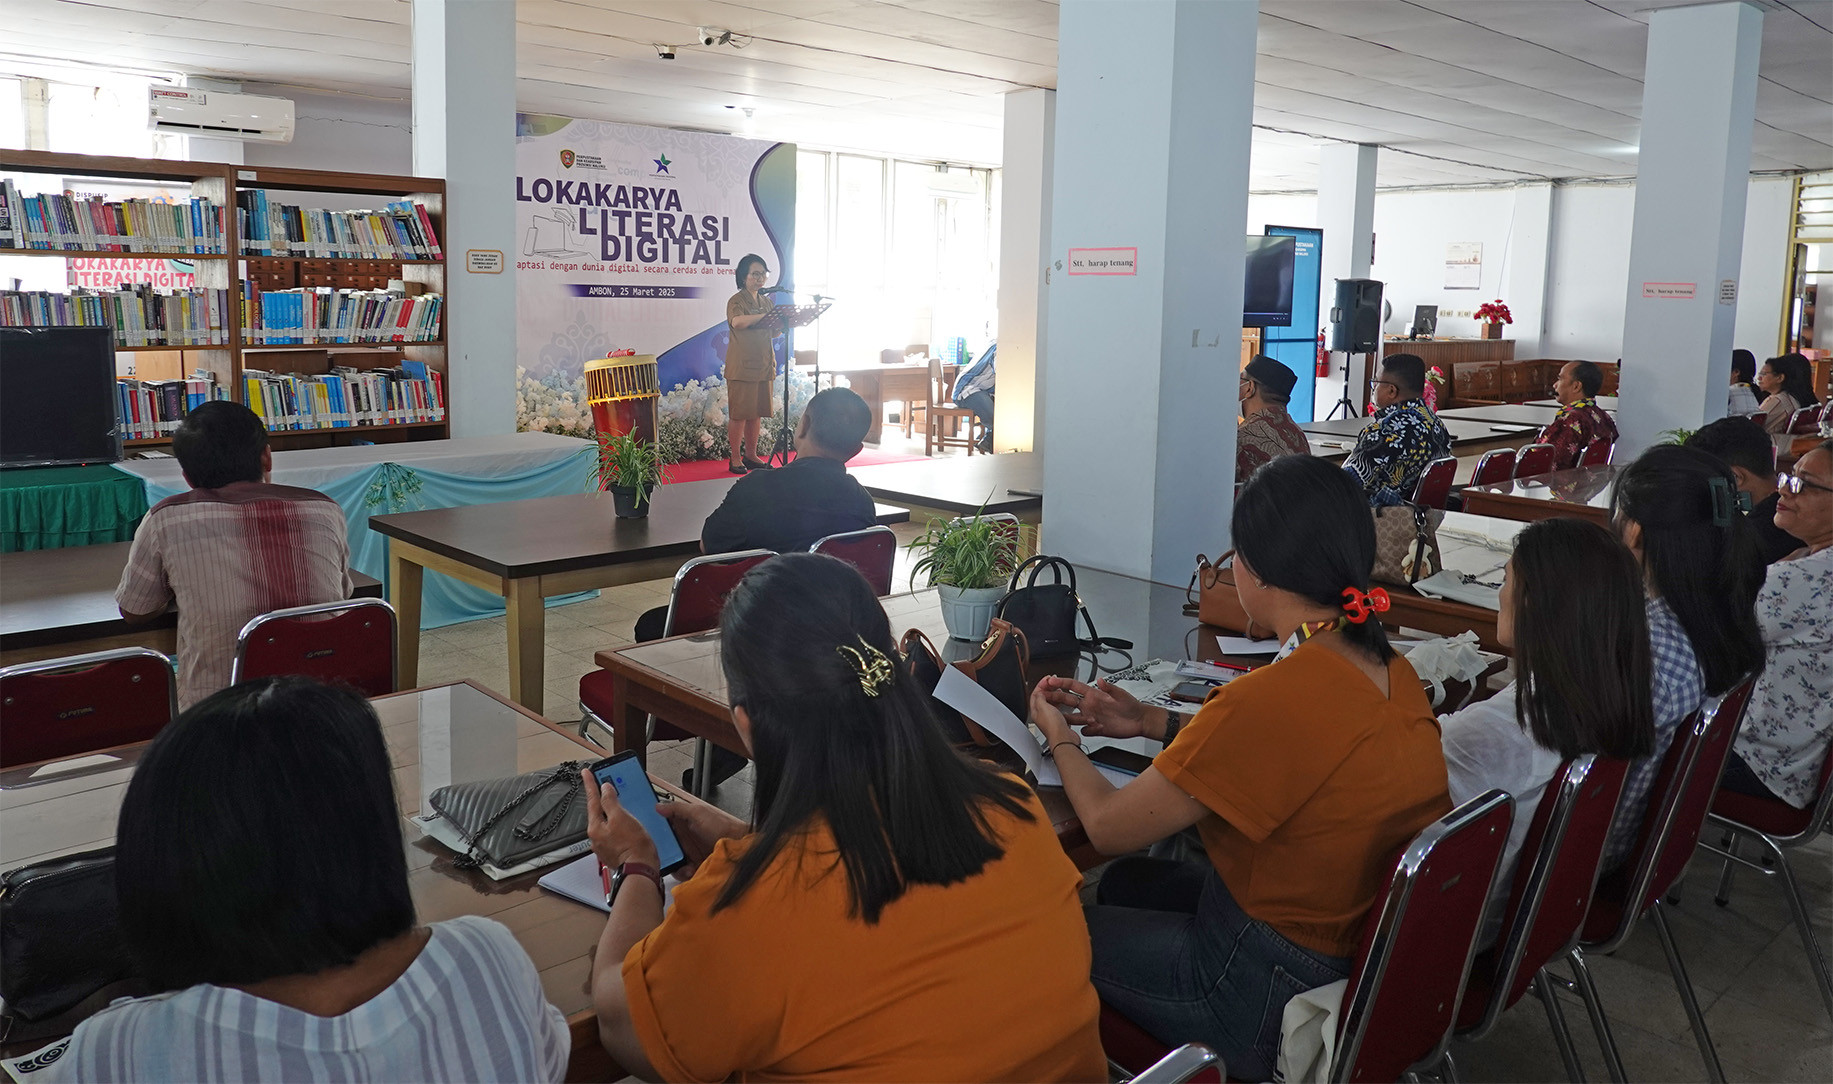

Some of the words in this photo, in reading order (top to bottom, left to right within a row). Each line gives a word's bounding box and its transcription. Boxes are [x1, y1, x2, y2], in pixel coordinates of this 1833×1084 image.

[516, 176, 683, 212] LOKAKARYA
[579, 207, 730, 242] LITERASI
[600, 234, 731, 266] DIGITAL
[516, 260, 546, 271] aptasi
[549, 261, 578, 273] dengan
[581, 262, 605, 272] dunia
[608, 263, 640, 274] digital
[643, 264, 669, 274] secara
[672, 265, 698, 275] cerdas
[700, 266, 714, 275] dan
[1088, 259, 1108, 268] harap
[1110, 260, 1134, 268] tenang
[588, 286, 616, 298] AMBON,
[620, 287, 630, 296] 25
[632, 287, 655, 297] Maret
[658, 287, 676, 297] 2025
